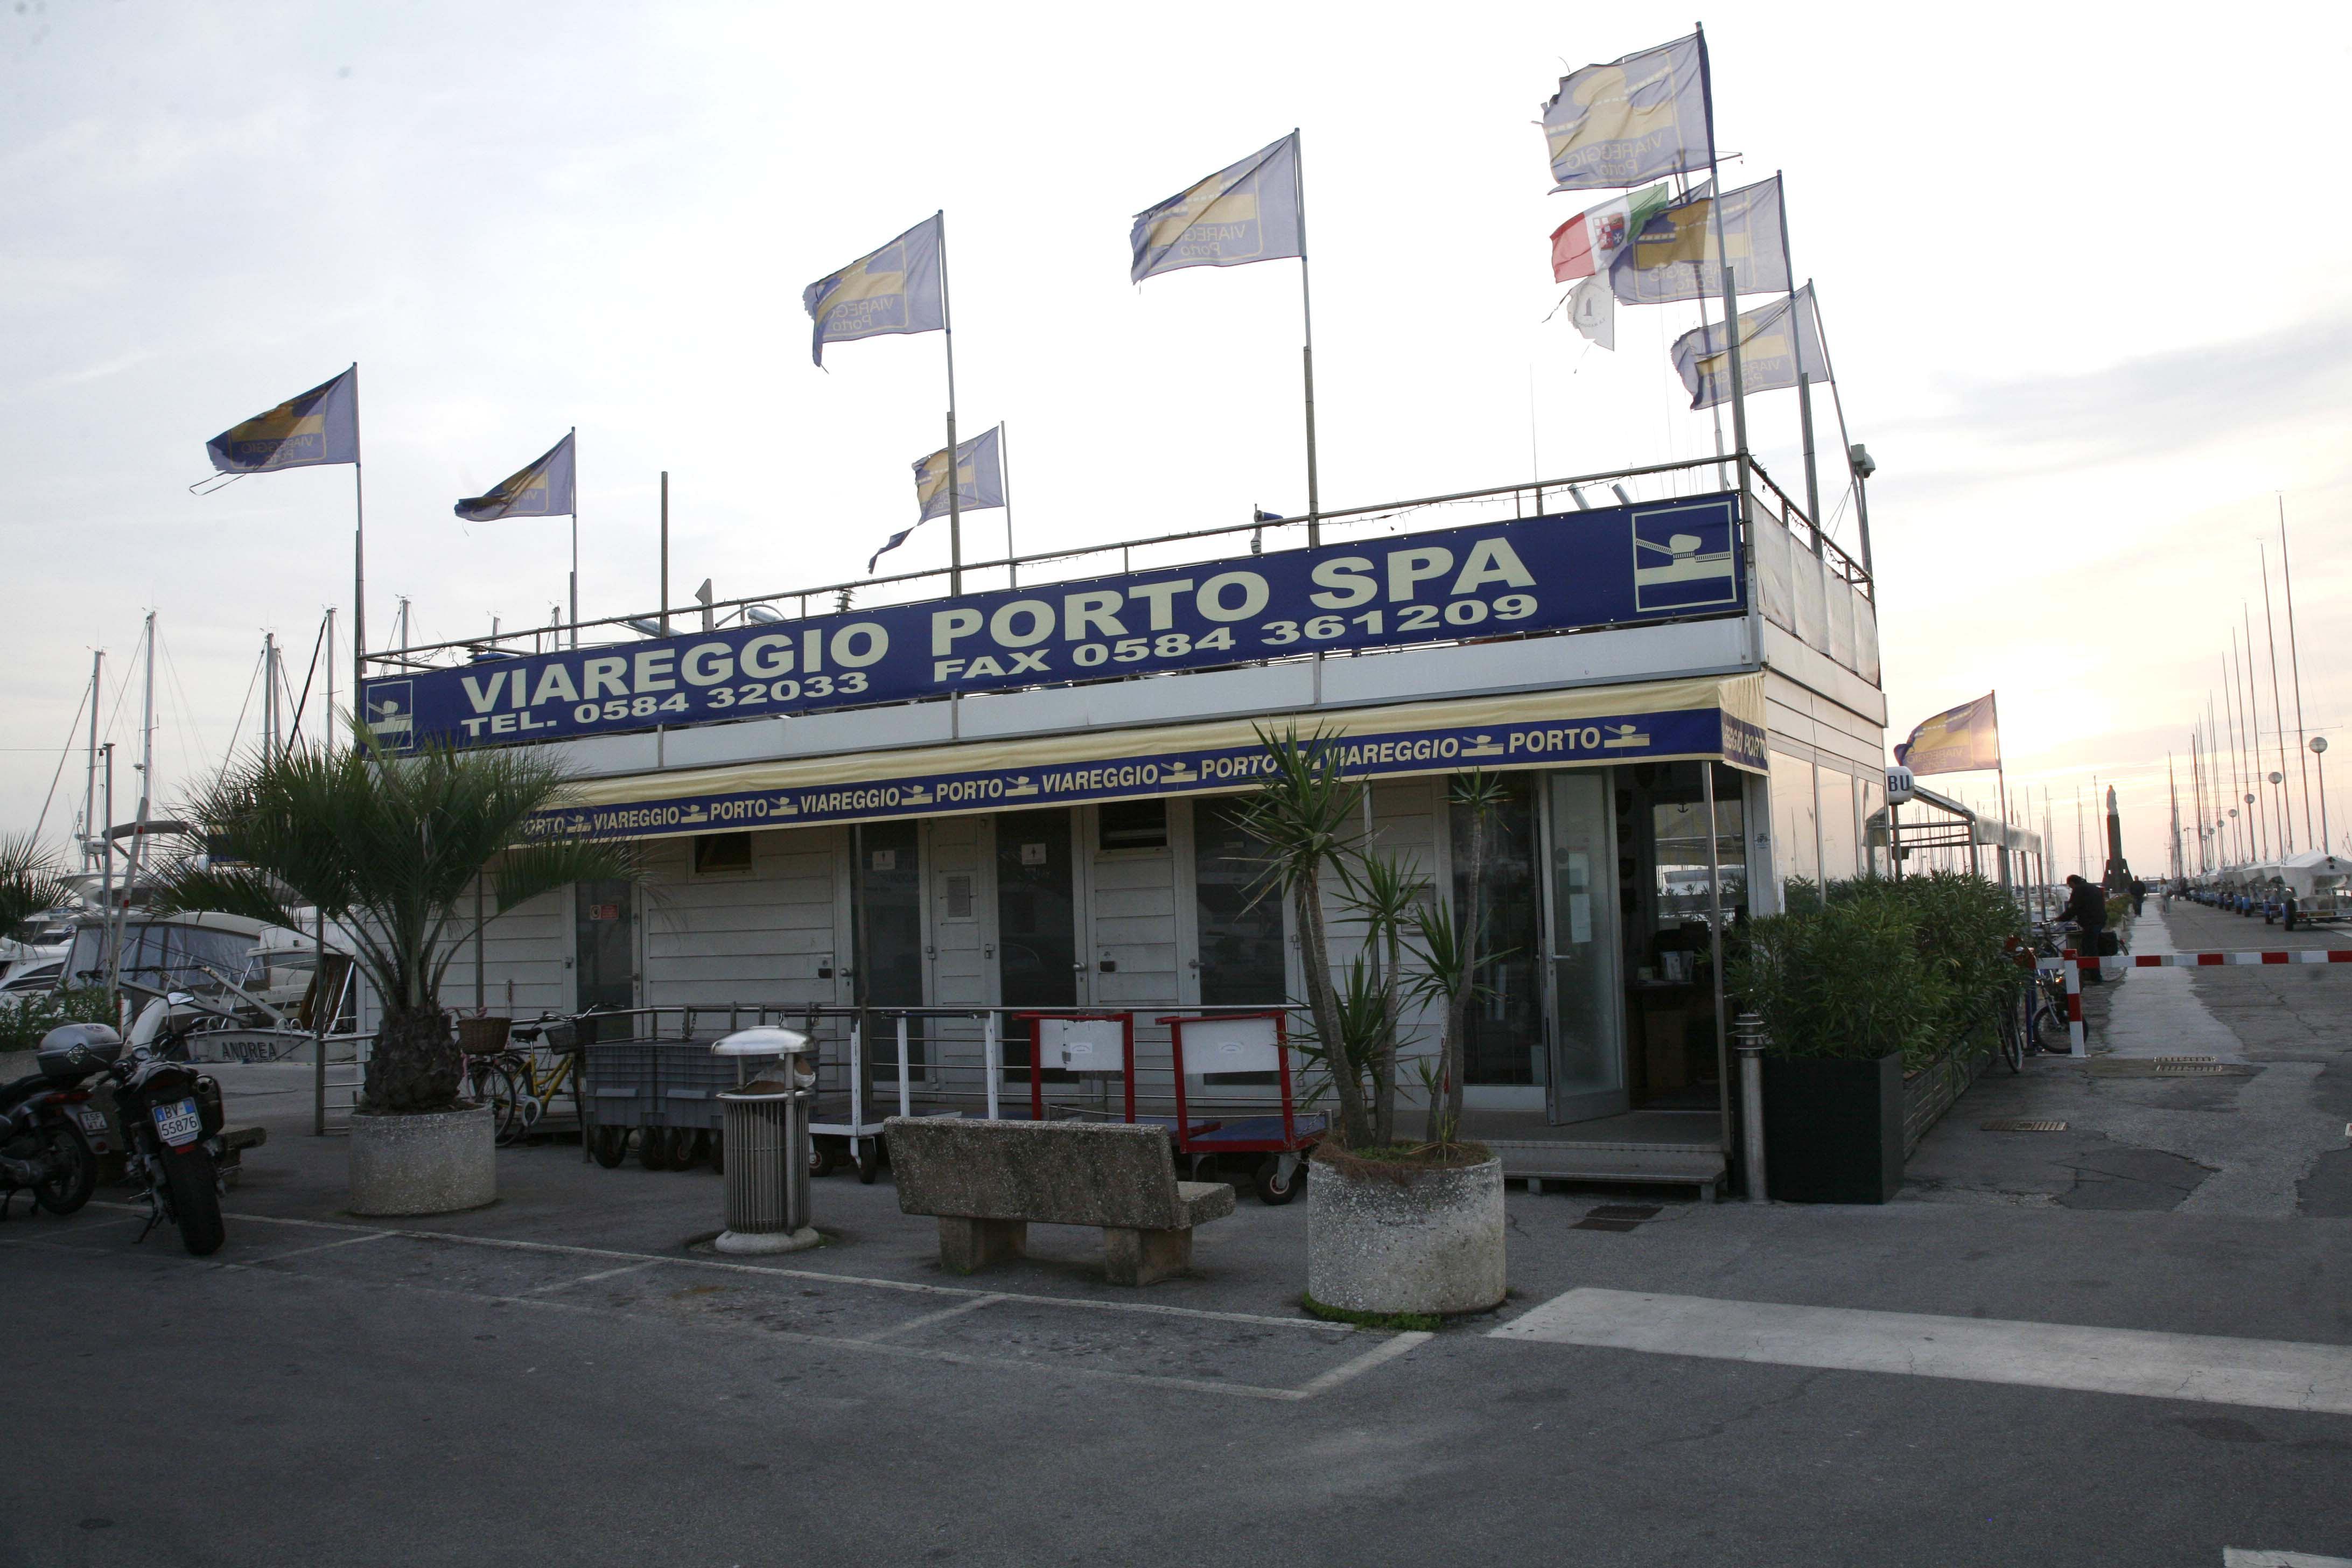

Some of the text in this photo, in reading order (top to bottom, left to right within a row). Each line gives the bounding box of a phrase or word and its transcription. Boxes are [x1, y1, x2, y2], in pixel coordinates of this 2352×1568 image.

[461, 594, 1537, 736] TEL. 0584 32033 FAX 0584 361209
[462, 537, 1536, 713] VIAREGGIO PORTO SPA
[519, 727, 1600, 835] ORTO VIAREGGIO PORTO VIAREGGIO PORTO VIAREGGIO PORTO VIAREGGIO PORTO
[222, 1041, 277, 1060] ANDREA
[161, 1116, 198, 1136] 55876
